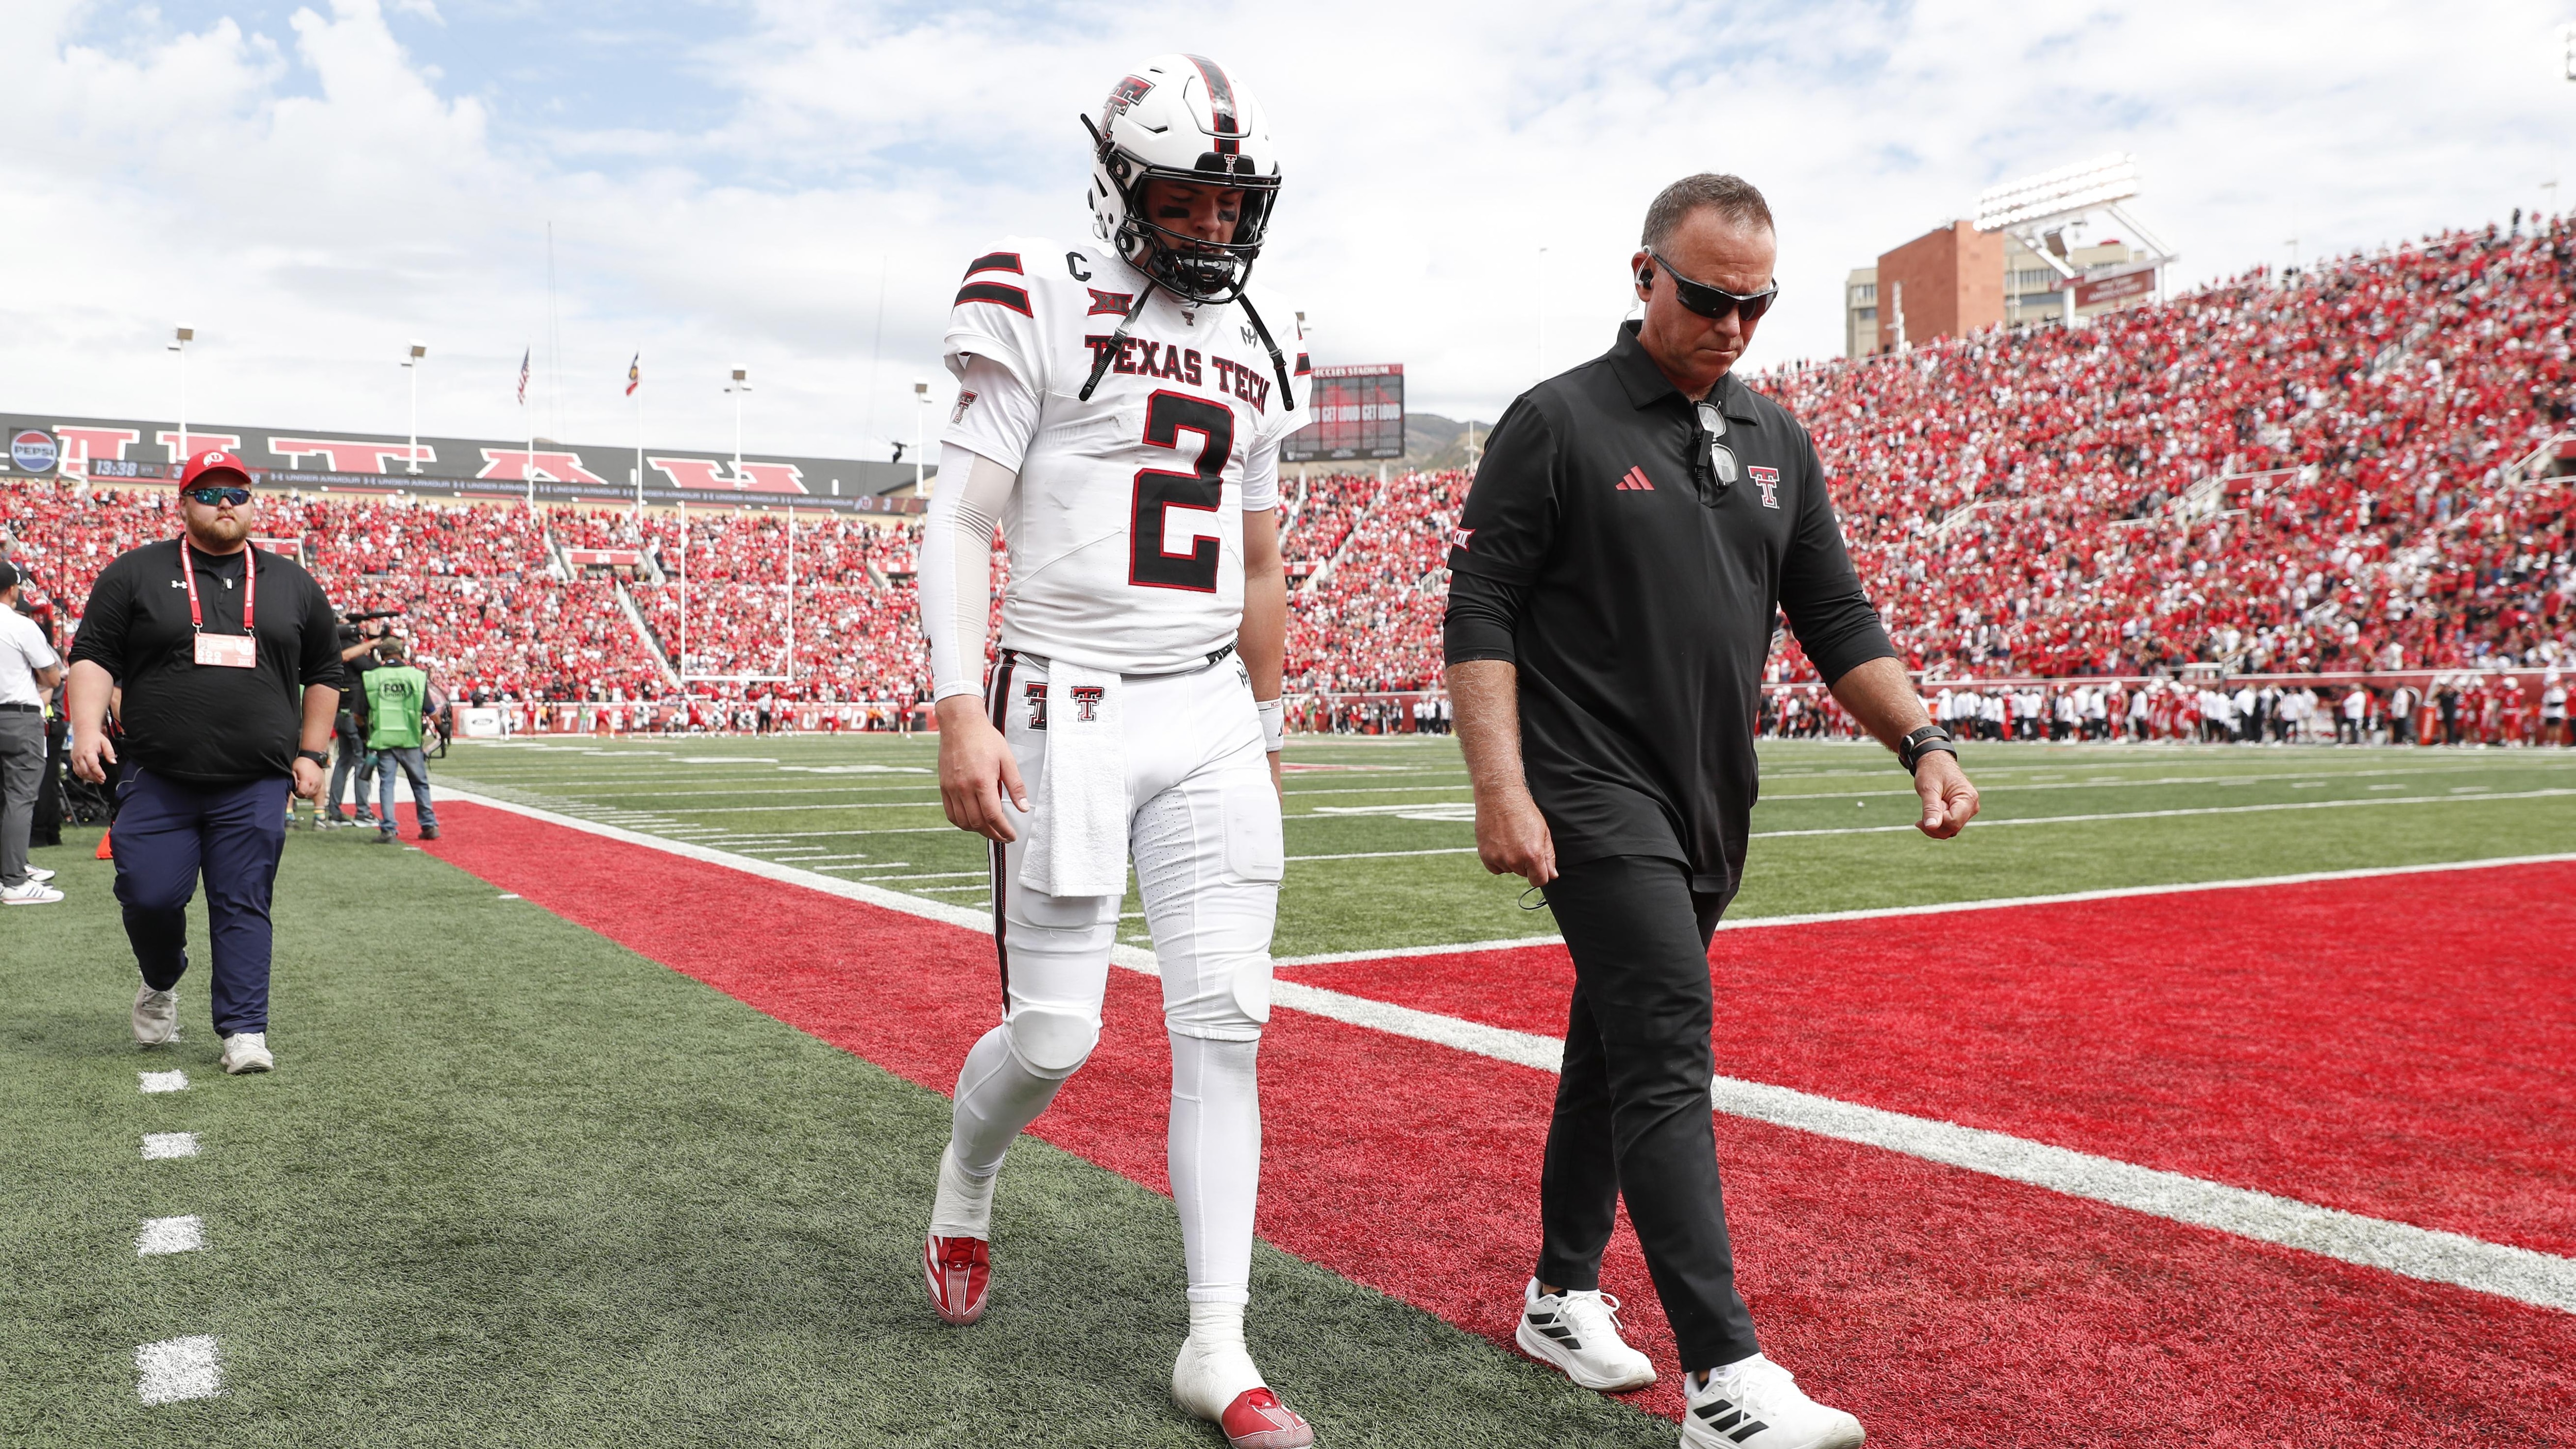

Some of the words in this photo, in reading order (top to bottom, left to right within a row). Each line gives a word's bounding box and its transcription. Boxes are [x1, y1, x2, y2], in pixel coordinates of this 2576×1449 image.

[1066, 251, 1091, 282] C
[1085, 335, 1202, 386] TEXAS
[1212, 356, 1270, 416] TECH
[1348, 365, 1389, 376] STADIUM
[14, 446, 55, 457] PEPSI
[95, 460, 138, 477] 13:38
[286, 473, 318, 482] UNDER
[319, 476, 361, 484] ARMOUR
[377, 478, 410, 486] UNDER
[411, 479, 450, 488] ARMOUR
[467, 482, 498, 490] UNDER
[1129, 389, 1234, 593] 2
[384, 683, 405, 693] FOX
